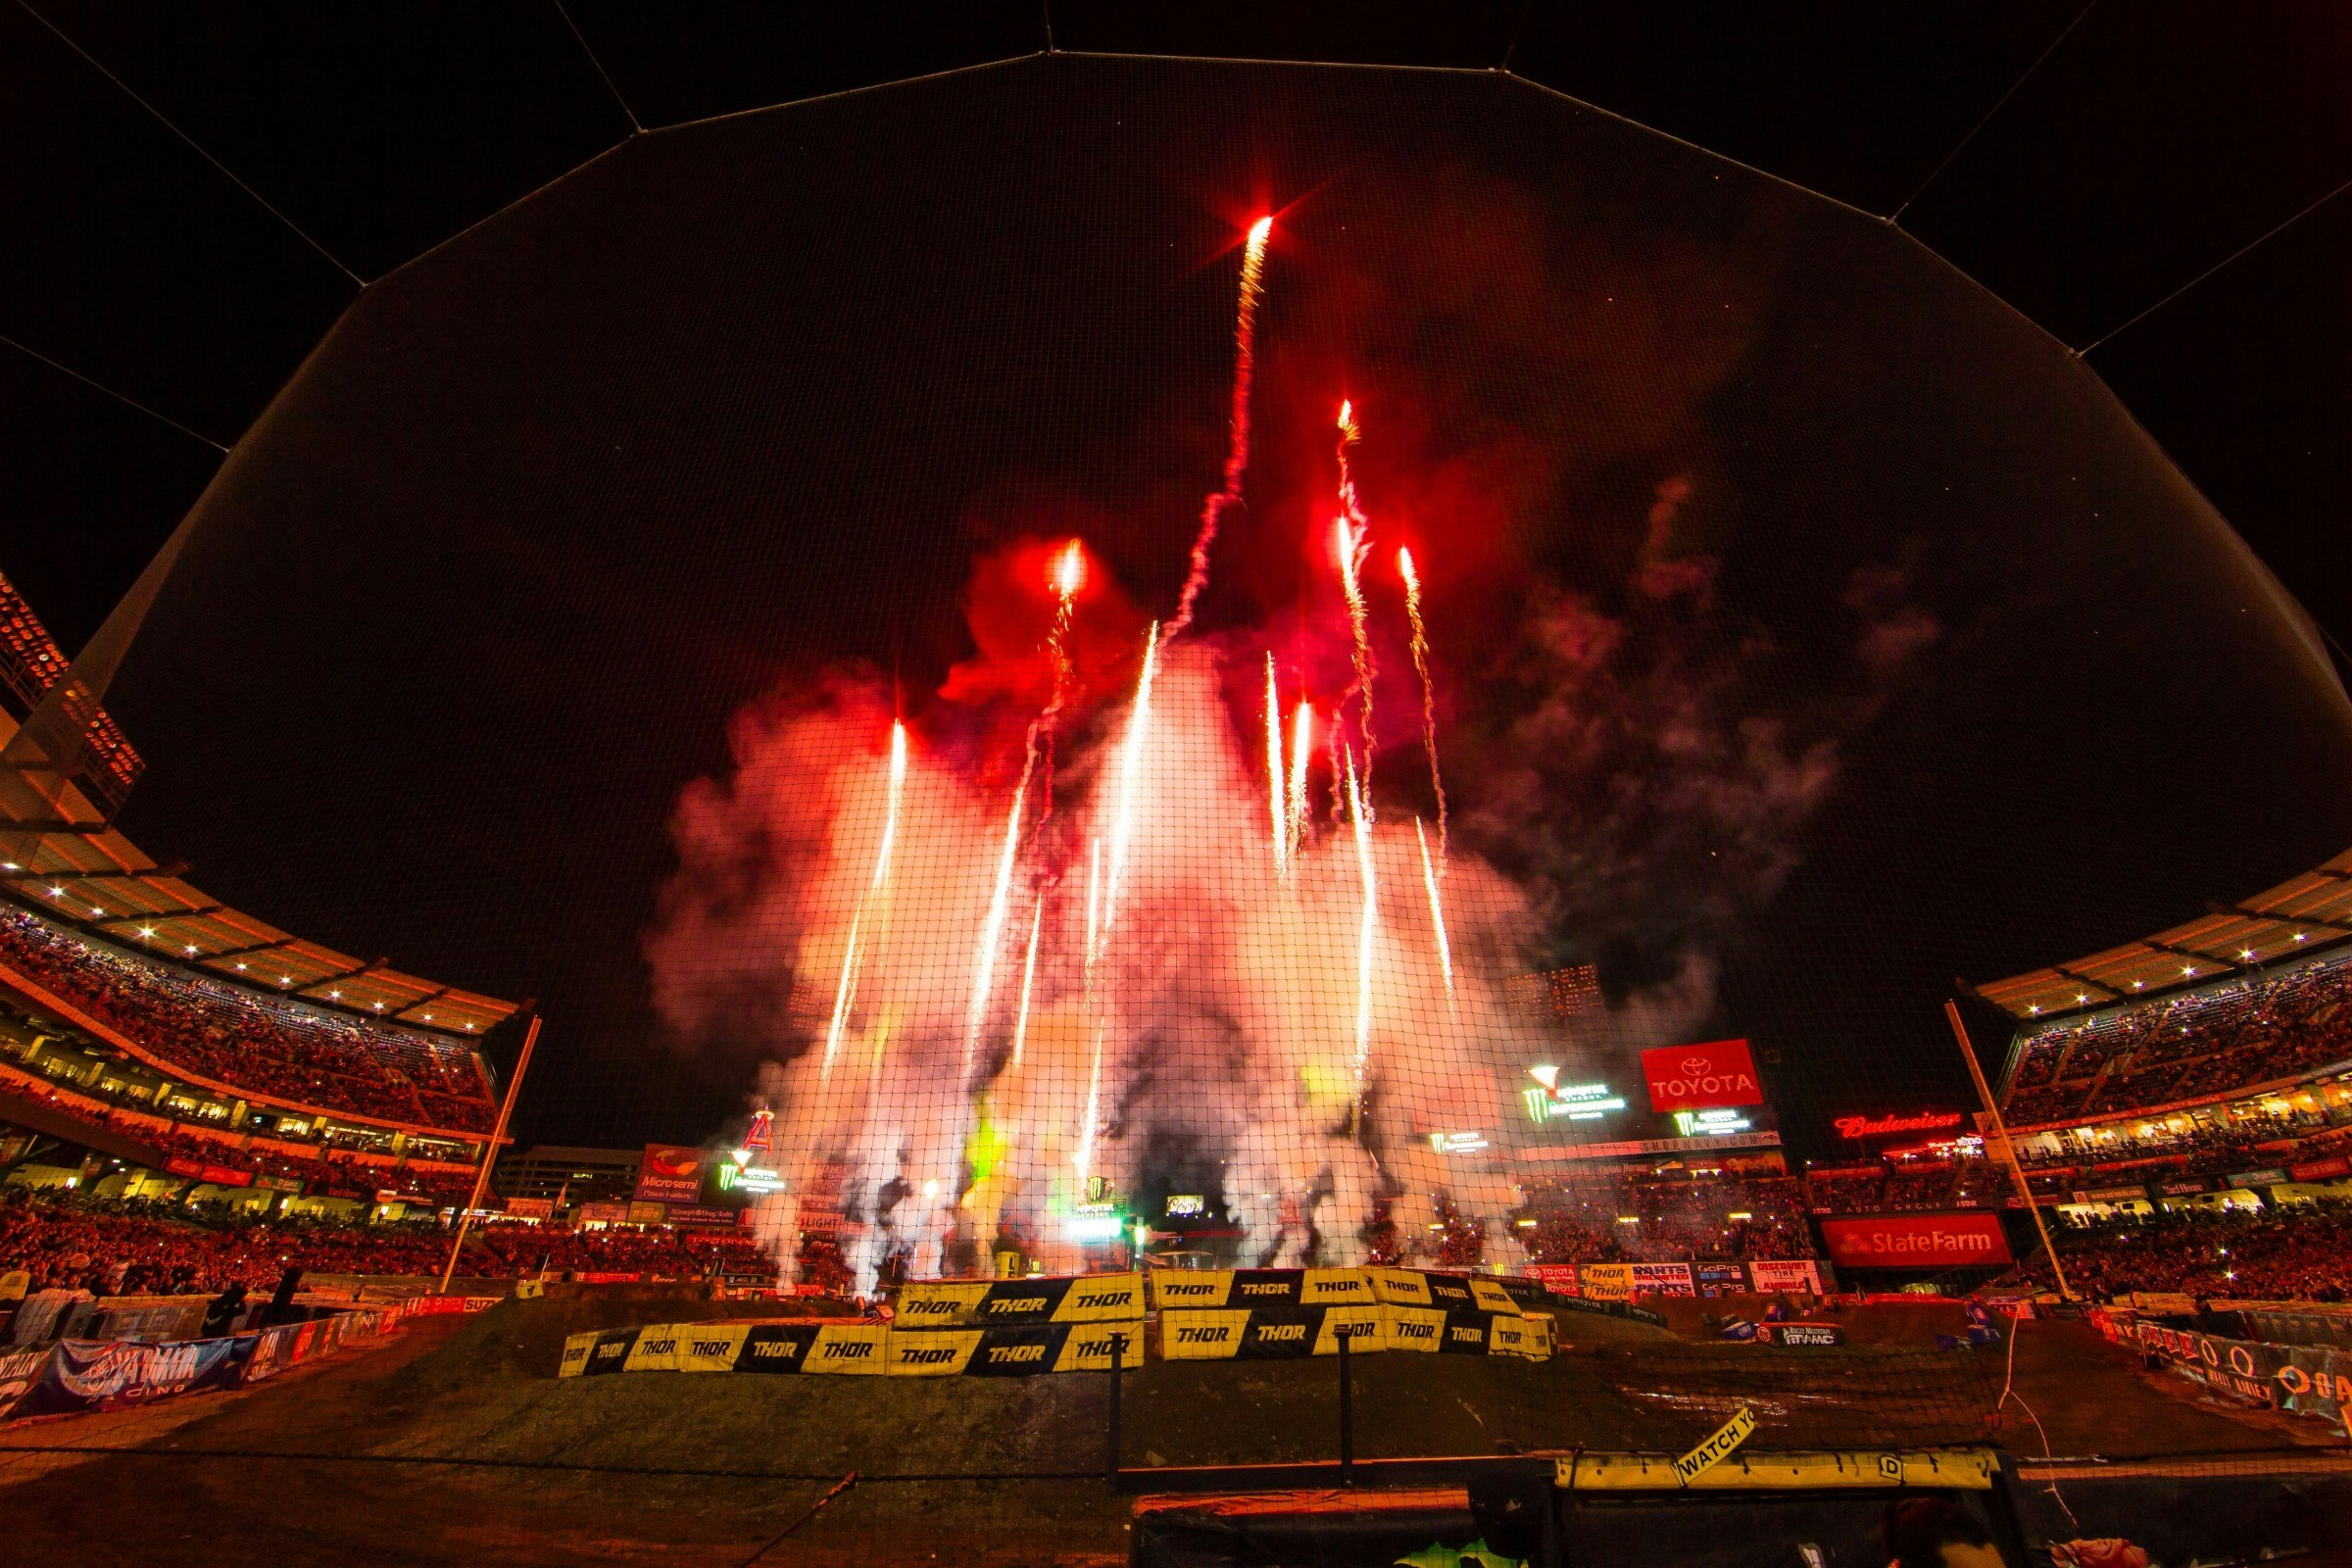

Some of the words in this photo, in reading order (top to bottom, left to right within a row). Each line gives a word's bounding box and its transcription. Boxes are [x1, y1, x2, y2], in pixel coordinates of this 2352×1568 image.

[1652, 1074, 1755, 1098] TOYOTA
[1834, 1111, 1961, 1138] Budweiser
[642, 1177, 699, 1190] Microsemi
[2164, 1186, 2180, 1195] Yard
[2180, 1183, 2203, 1193] House
[1873, 1232, 1930, 1253] State
[1933, 1230, 1991, 1251] Farm
[1592, 1269, 1626, 1279] THOR
[1632, 1265, 1688, 1275] PARTS
[1756, 1262, 1807, 1271] DISCOUNT
[1164, 1284, 1215, 1296] THOR
[1241, 1283, 1291, 1296] THOR
[1314, 1281, 1359, 1293] THOR
[1384, 1280, 1419, 1293] THOR
[1435, 1286, 1469, 1298] THOR
[1480, 1292, 1509, 1302] THOR
[1546, 1285, 1578, 1294] TOYOTA
[905, 1299, 962, 1314] THOR
[989, 1298, 1048, 1313] THOR
[1077, 1292, 1132, 1308] THOR
[1177, 1327, 1230, 1343] THOR
[1257, 1325, 1306, 1342] THOR
[1397, 1322, 1435, 1339] THOR
[1451, 1326, 1483, 1343] THOR
[1498, 1331, 1521, 1345] THOR
[564, 1348, 586, 1362] THOR
[598, 1343, 626, 1358] THOR
[643, 1340, 676, 1355] THOR
[692, 1341, 731, 1356] THOR
[753, 1342, 799, 1358] THOR
[824, 1342, 873, 1358] THOR
[901, 1348, 956, 1364] THOR
[988, 1344, 1047, 1363] THOR
[1681, 1428, 1740, 1477] WATCH
[1886, 1459, 1899, 1475] D
